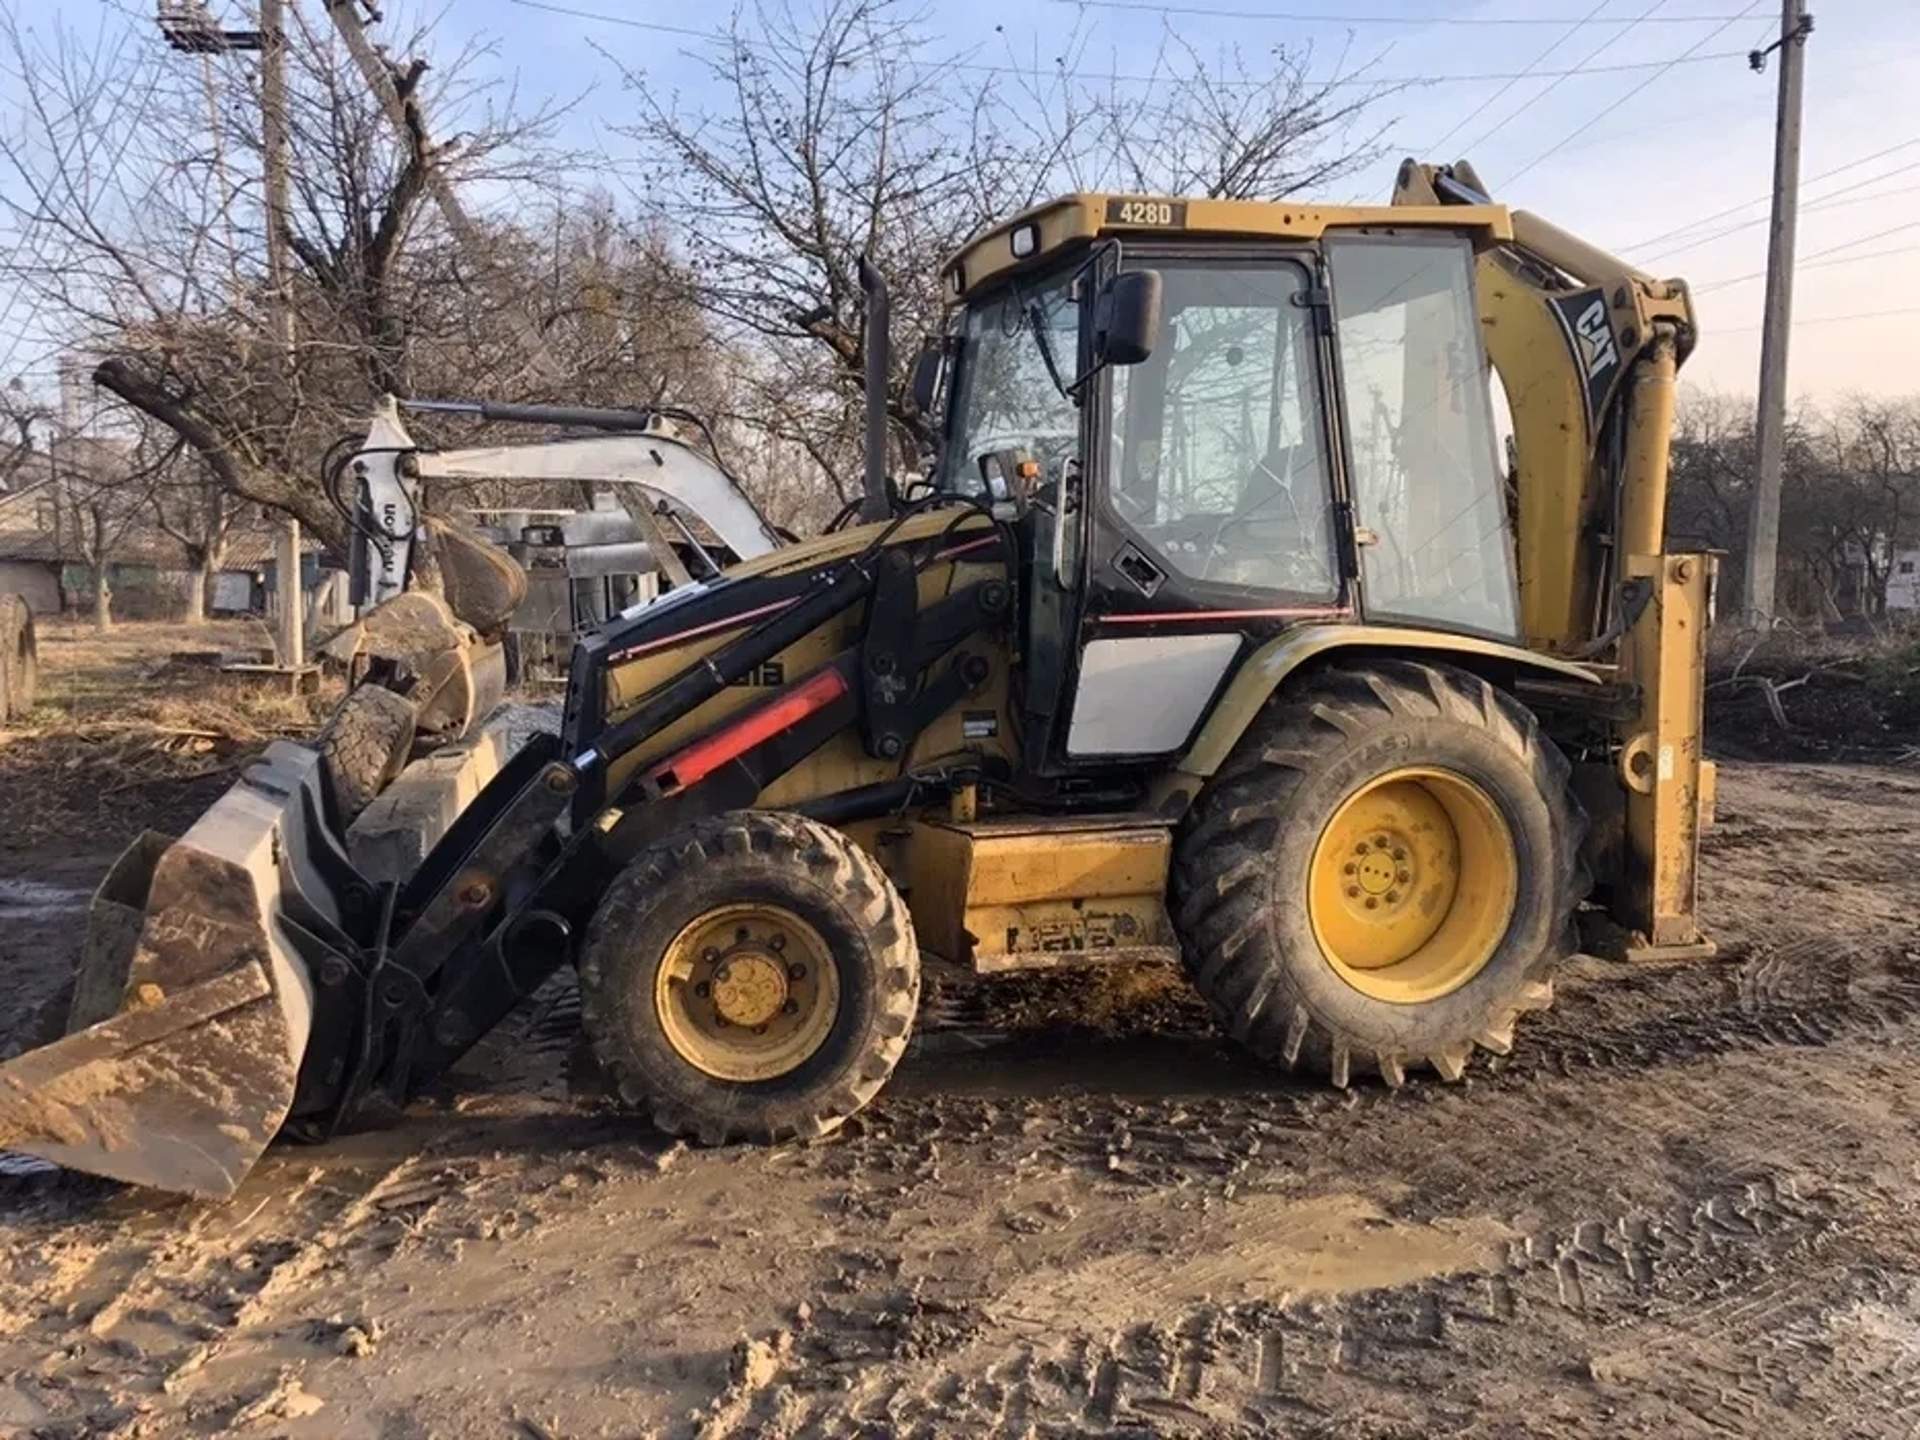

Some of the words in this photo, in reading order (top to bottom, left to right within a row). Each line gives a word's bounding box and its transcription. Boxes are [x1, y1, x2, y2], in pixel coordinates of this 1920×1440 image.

[1120, 202, 1172, 224] 428D
[1575, 299, 1619, 379] CAT
[382, 503, 397, 573] neon
